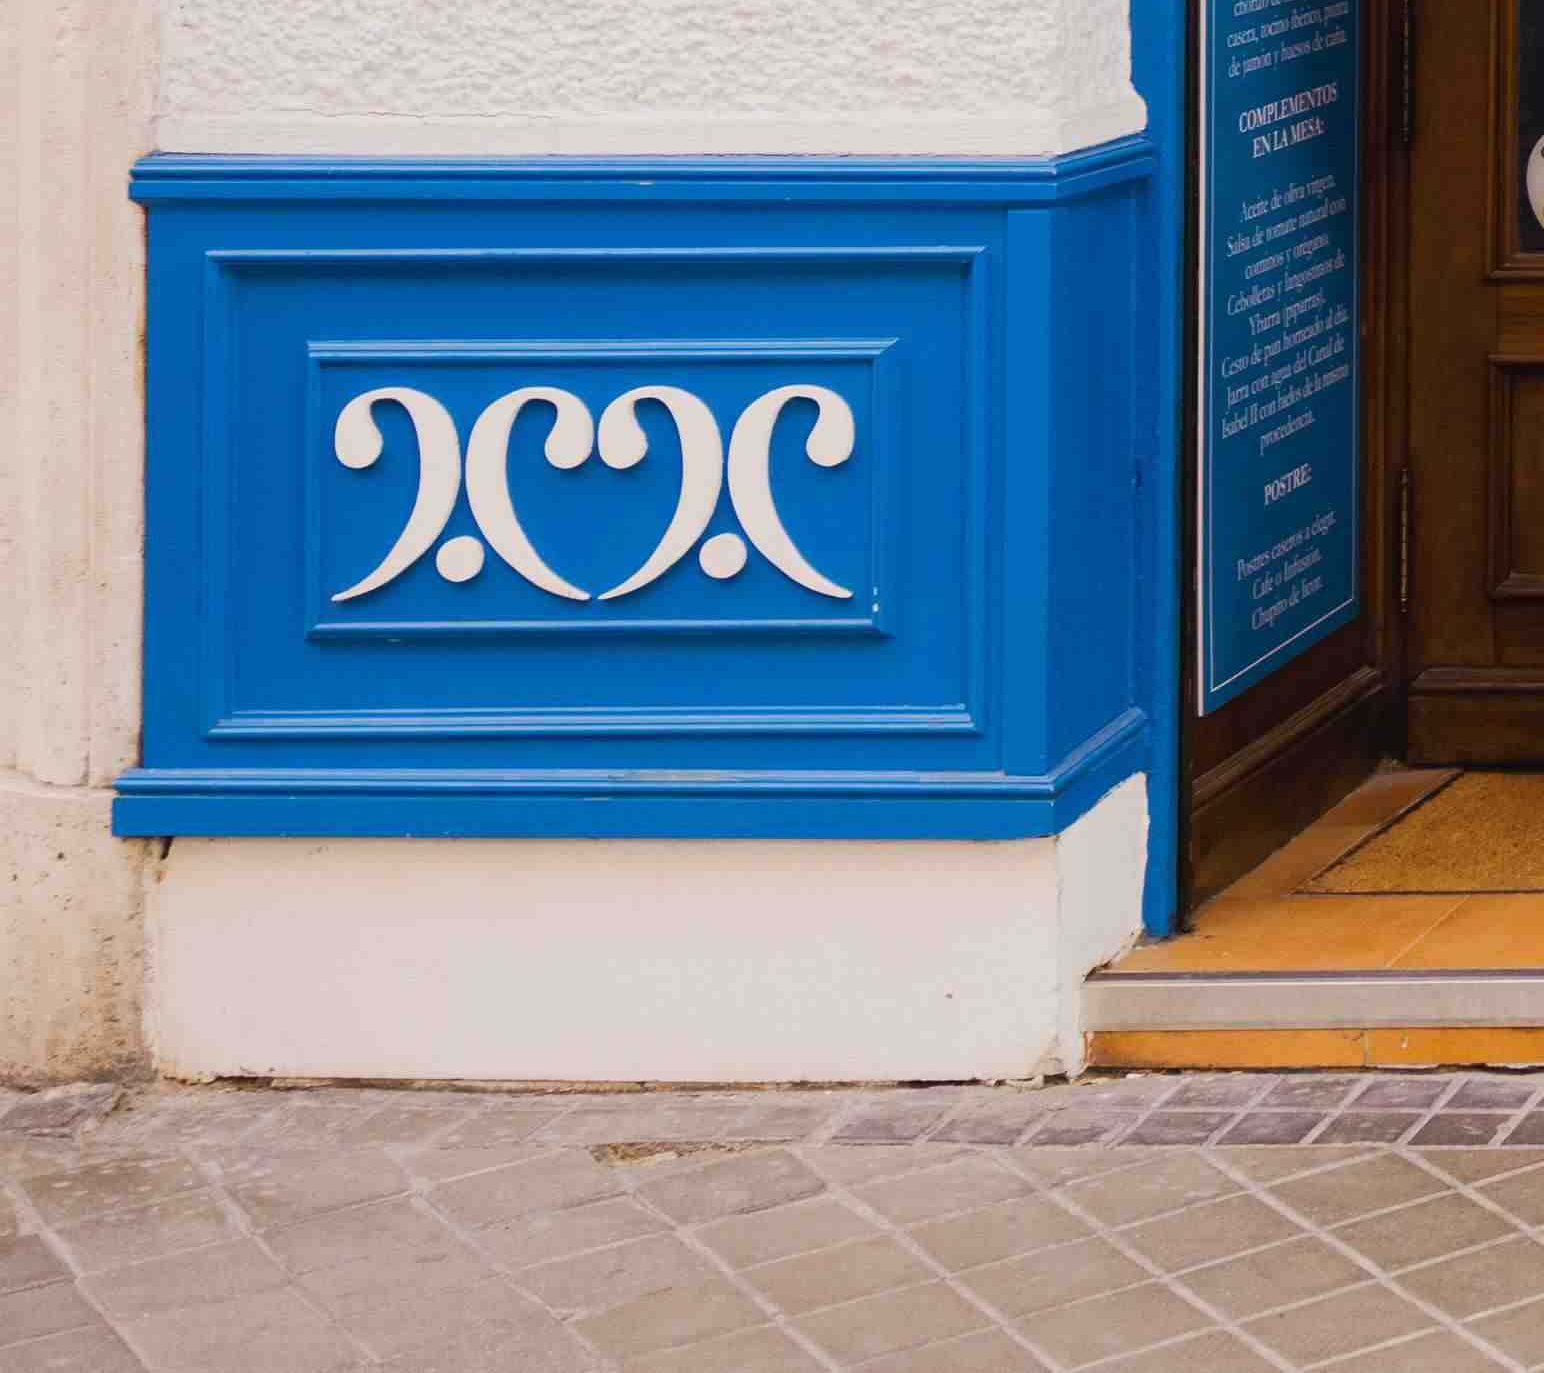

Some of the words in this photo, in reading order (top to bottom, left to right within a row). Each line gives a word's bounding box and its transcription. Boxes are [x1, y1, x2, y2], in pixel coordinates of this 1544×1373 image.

[1239, 83, 1337, 133] COMPLEMENTOS
[1253, 136, 1272, 158] EN
[1273, 130, 1289, 151] LA
